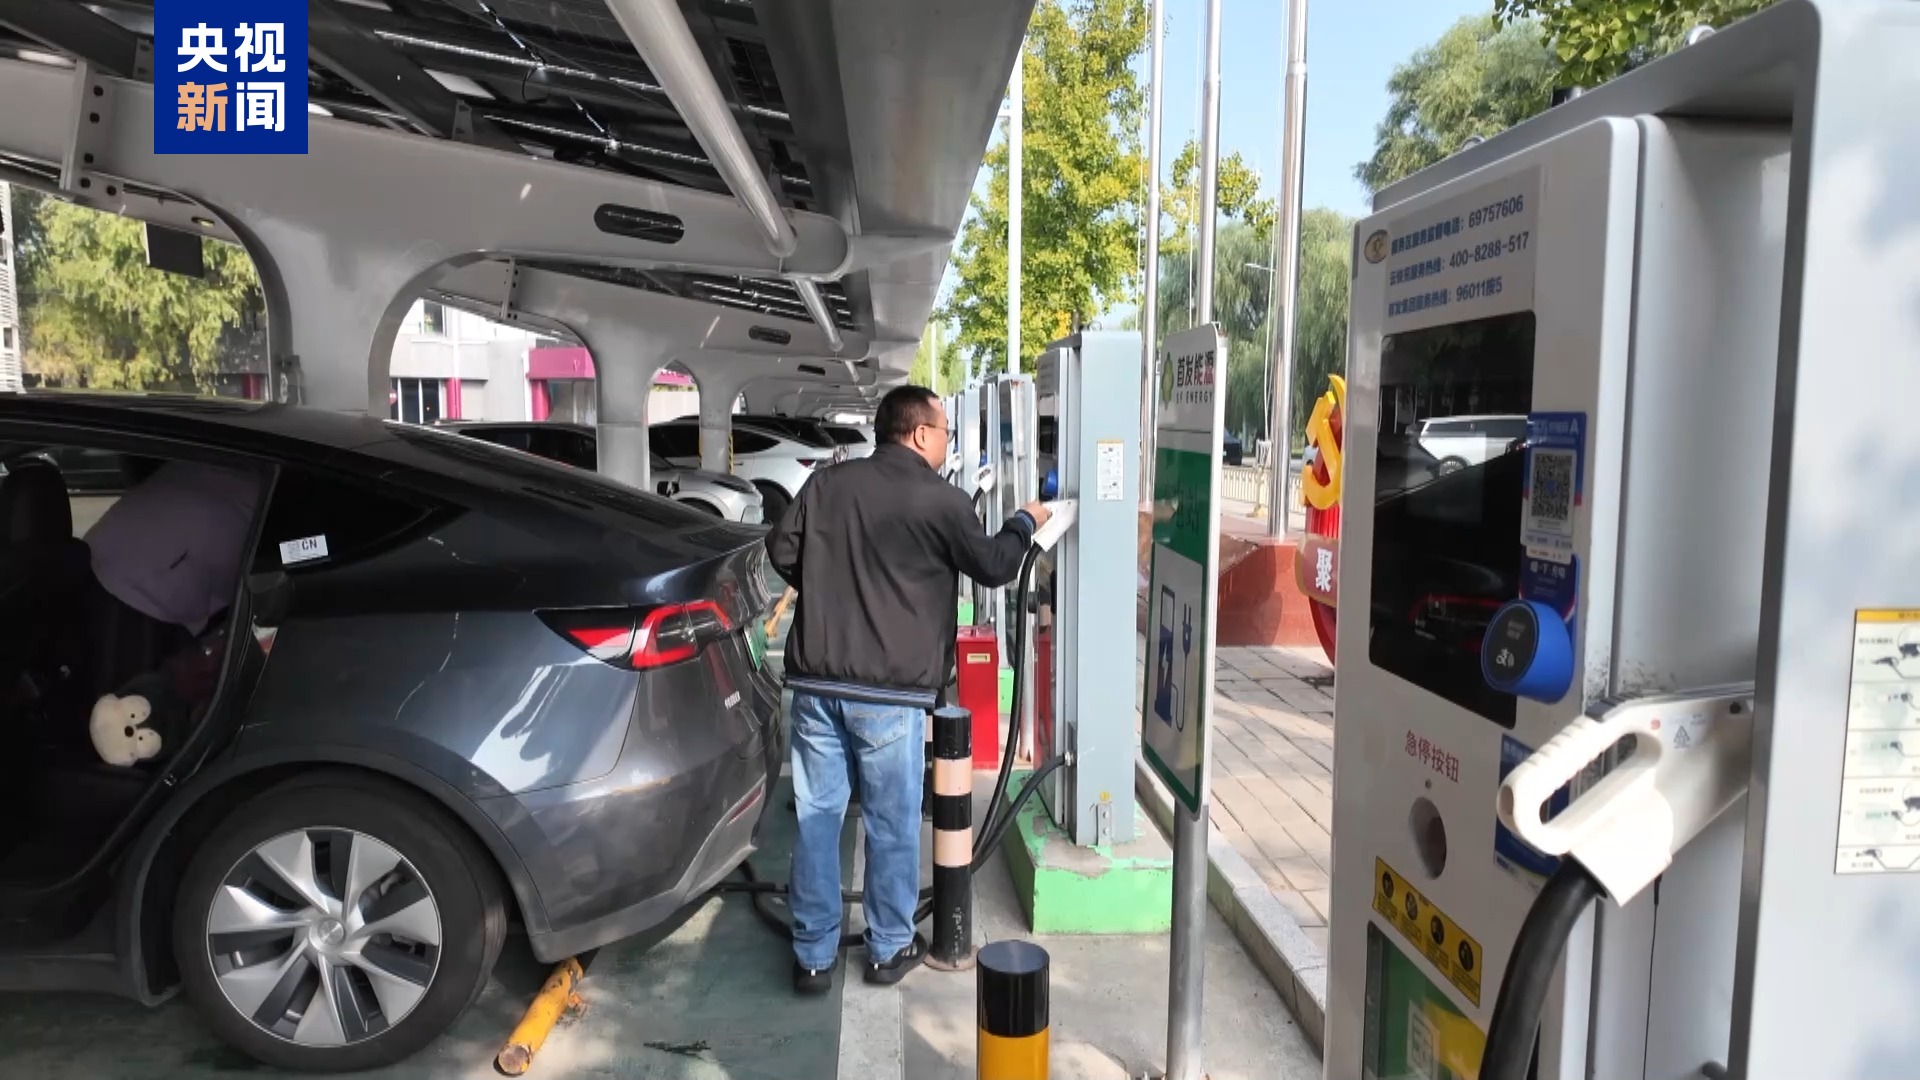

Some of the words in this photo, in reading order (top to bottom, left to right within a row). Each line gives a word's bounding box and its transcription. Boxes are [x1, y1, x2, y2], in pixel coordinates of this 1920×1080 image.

[1177, 350, 1214, 388] 首发能源
[301, 538, 317, 551] CN
[1315, 547, 1333, 592] 聚
[1404, 729, 1459, 783] 急停按钮
